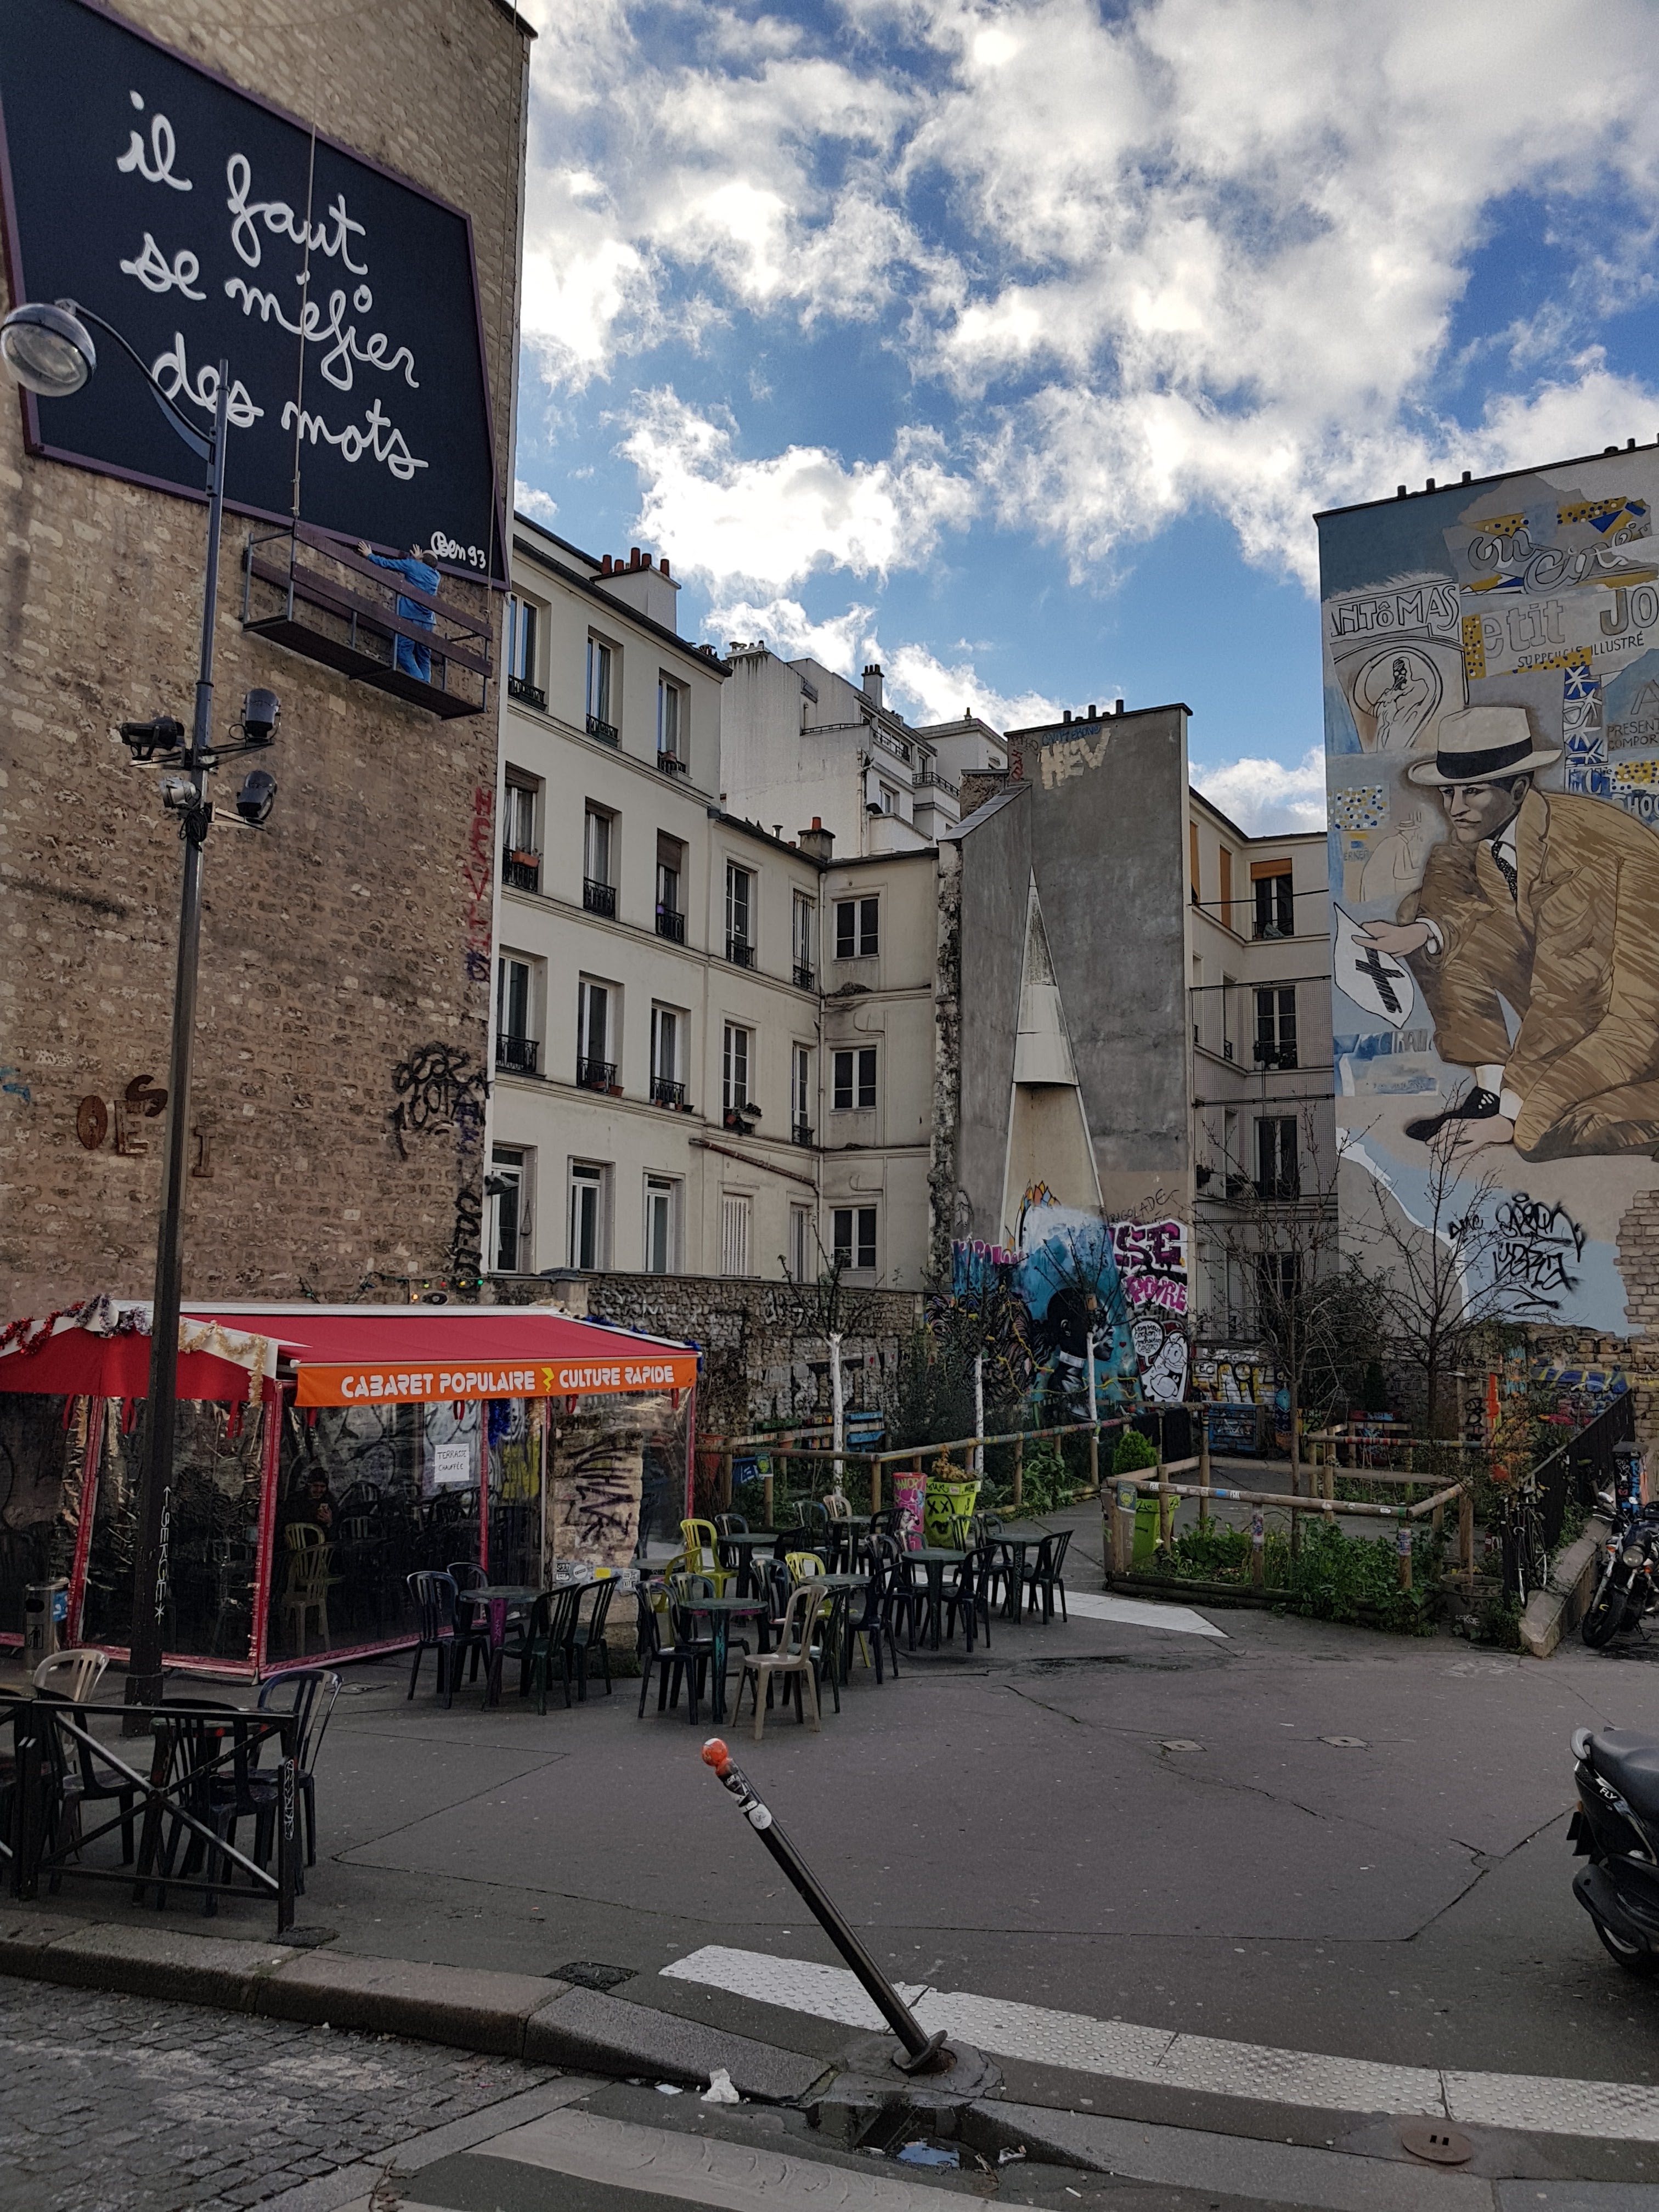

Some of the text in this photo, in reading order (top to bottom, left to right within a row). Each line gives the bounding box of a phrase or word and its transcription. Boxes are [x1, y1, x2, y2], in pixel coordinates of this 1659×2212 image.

[116, 90, 368, 275] il faut
[120, 232, 207, 300] se
[152, 331, 429, 480] des mots
[1591, 631, 1645, 656] ILLUSTRÉ
[341, 1365, 675, 1398] CABARET POPULAIRE CULTURE RAPIDE
[1599, 1787, 1617, 1799] FLY
